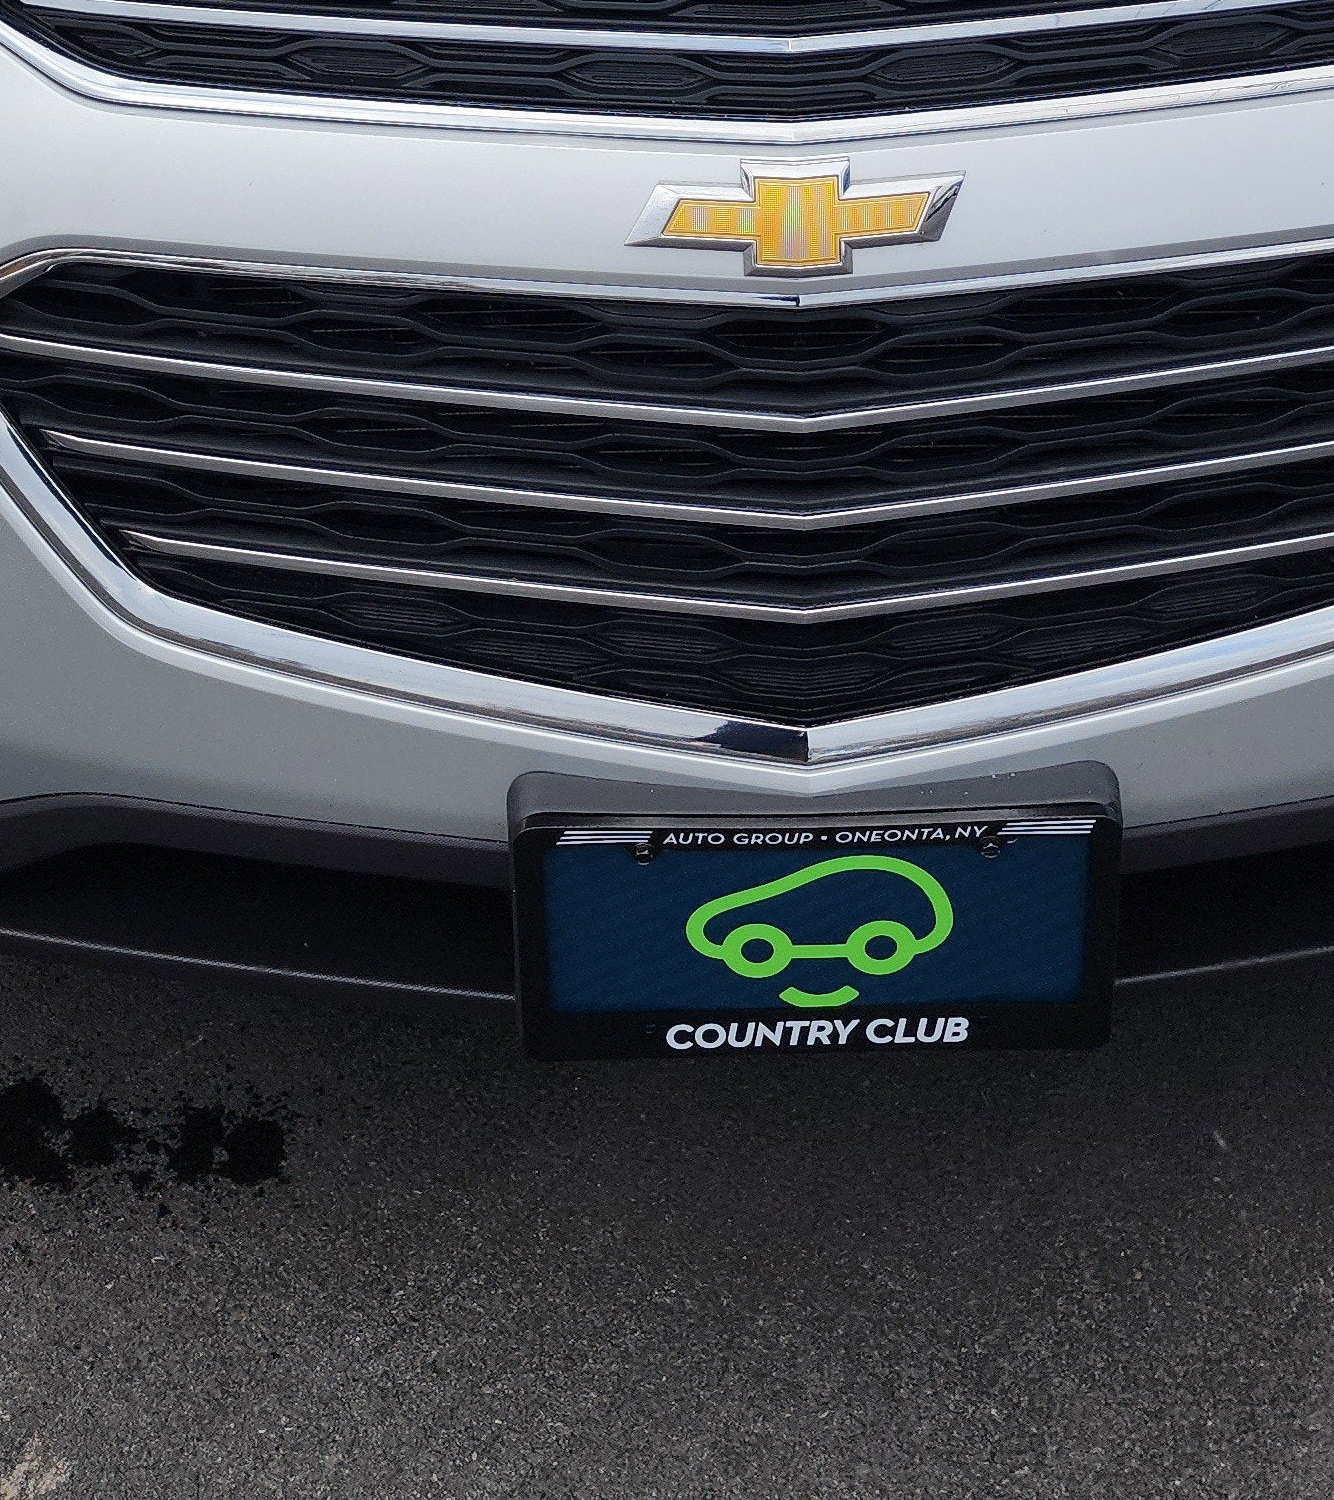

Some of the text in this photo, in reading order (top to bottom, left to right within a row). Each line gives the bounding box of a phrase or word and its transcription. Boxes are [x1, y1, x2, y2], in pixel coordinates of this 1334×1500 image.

[662, 832, 725, 845] AUTO
[732, 832, 814, 845] GROUP
[665, 1017, 970, 1050] COUNTRY CLUB
